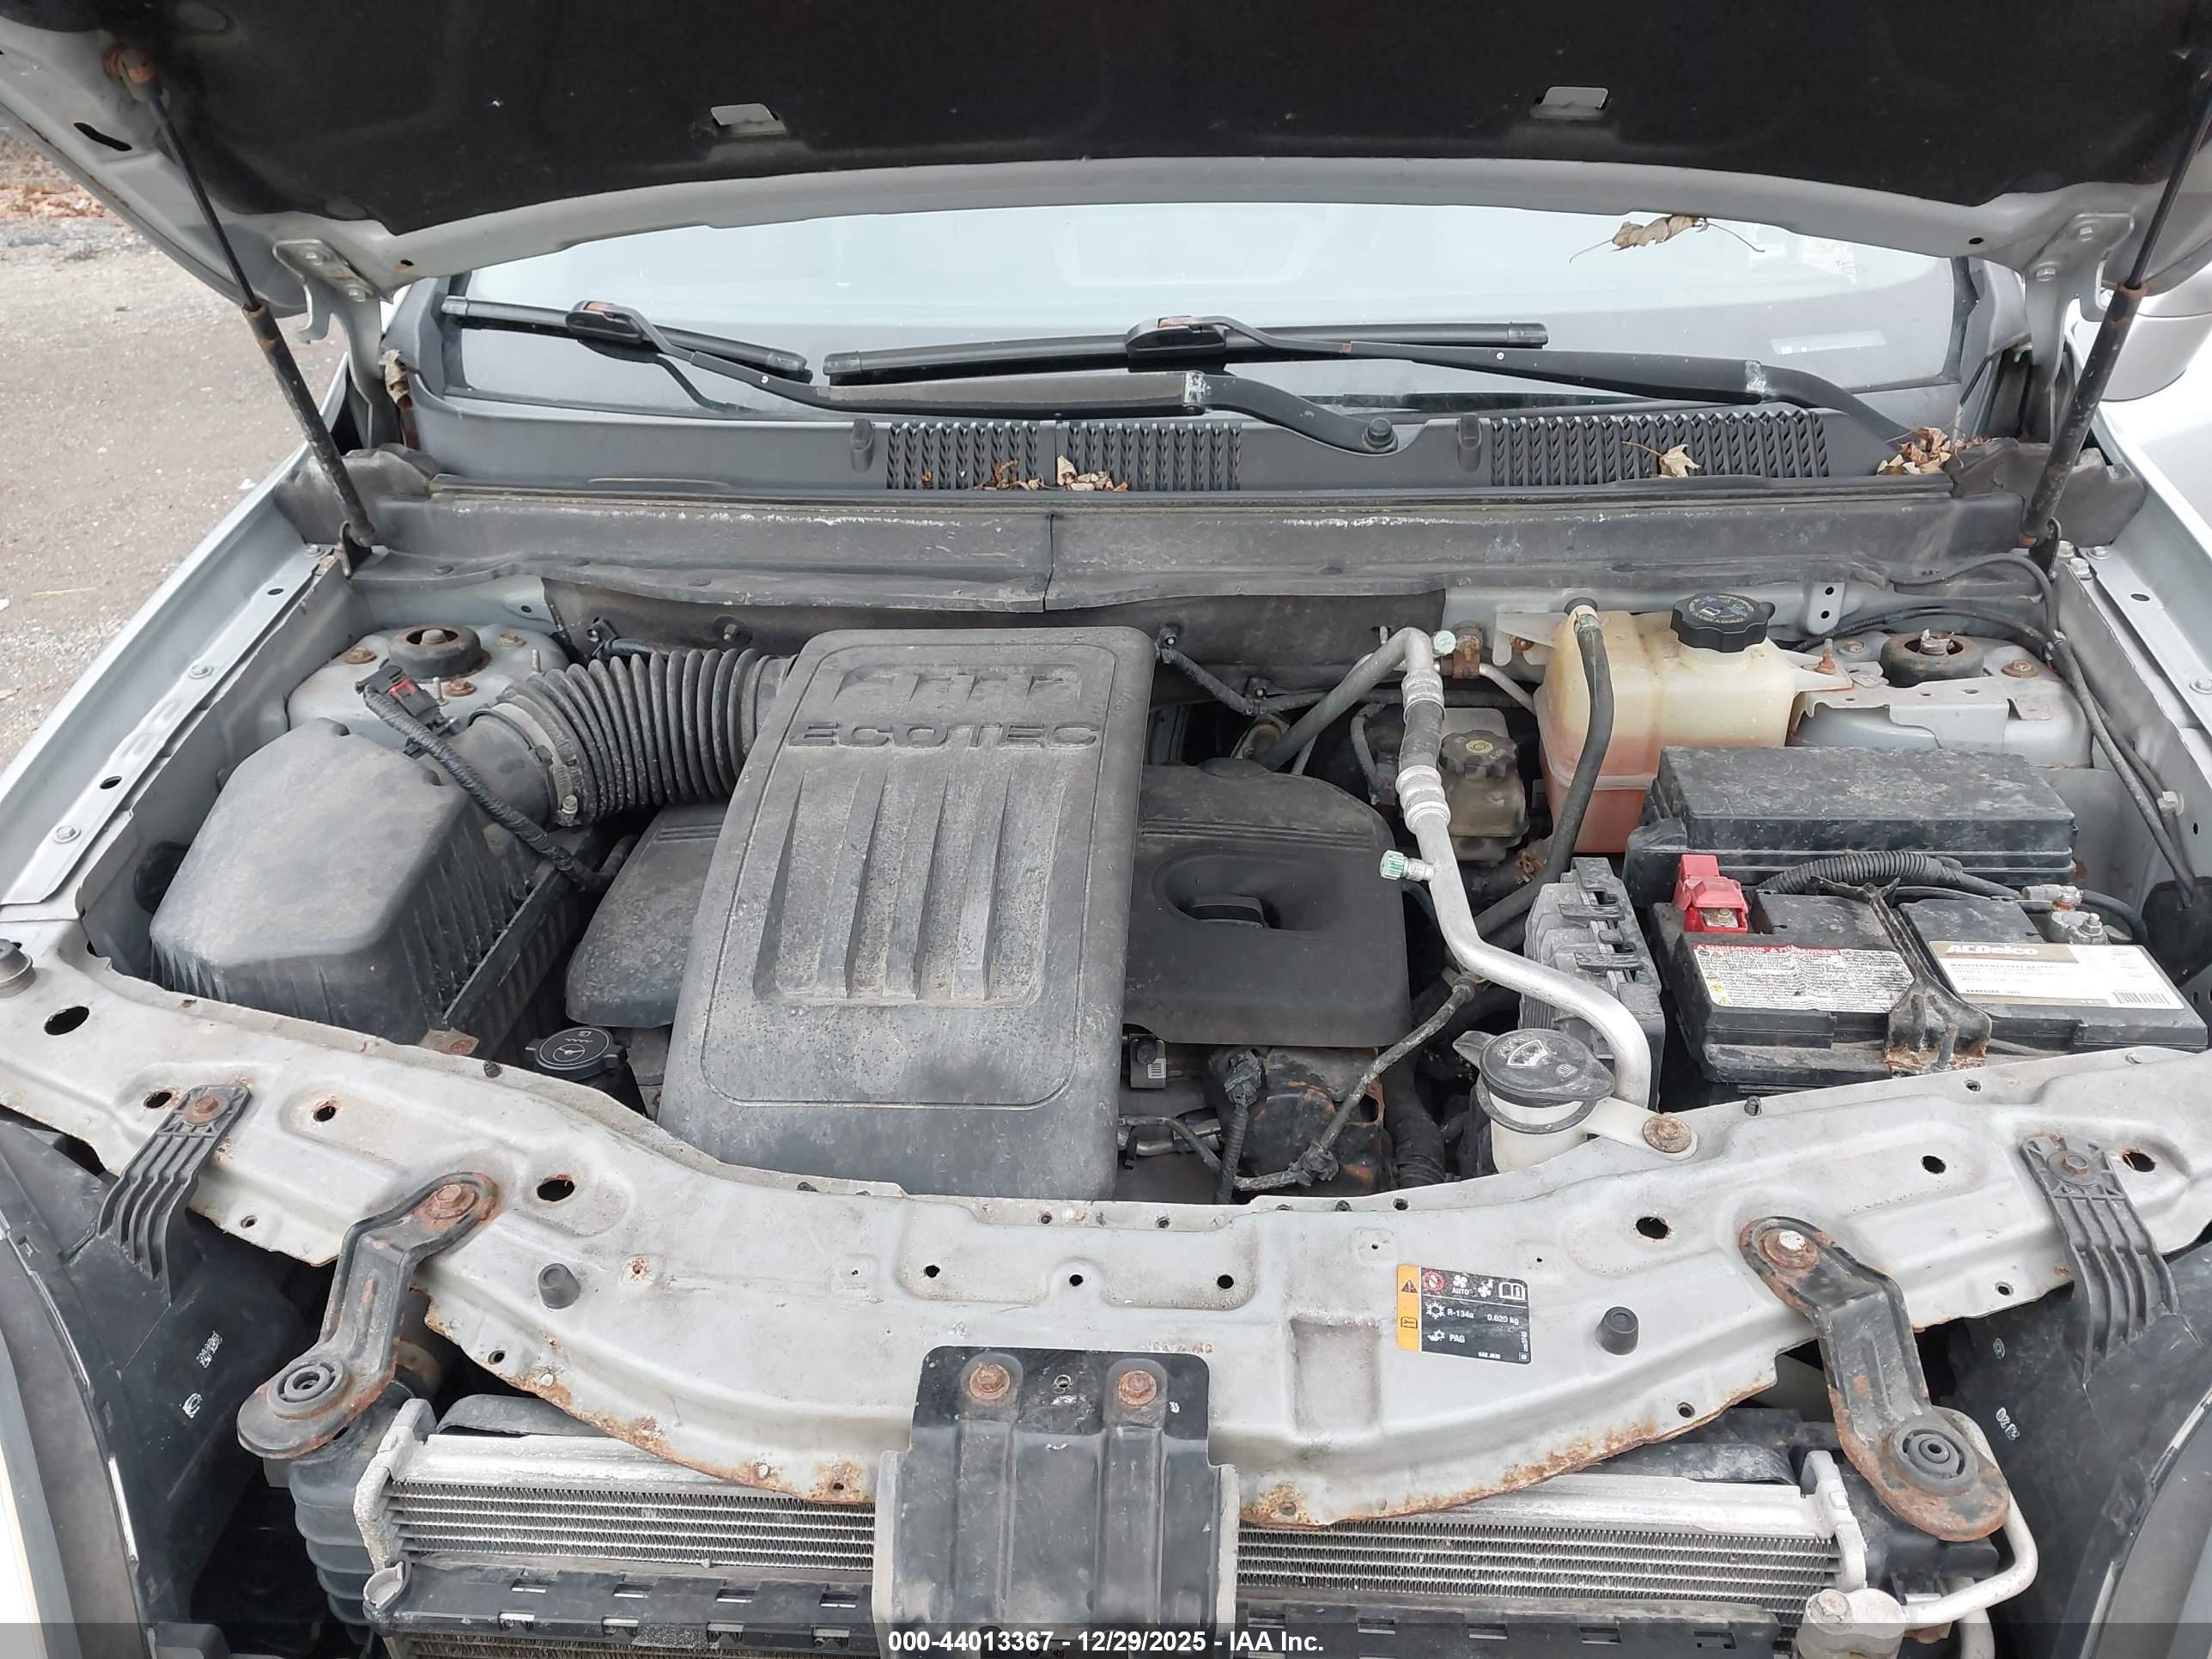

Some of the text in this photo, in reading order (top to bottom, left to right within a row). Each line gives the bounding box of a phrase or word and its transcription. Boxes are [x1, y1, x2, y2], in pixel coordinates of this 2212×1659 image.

[787, 721, 1100, 749] ECOTEC
[1946, 945, 2039, 956] ACDelco
[1451, 1286, 1470, 1295] AUTO
[1447, 1308, 1474, 1319] R-134a
[1510, 1316, 1519, 1326] kg
[1449, 1334, 1466, 1343] PAG
